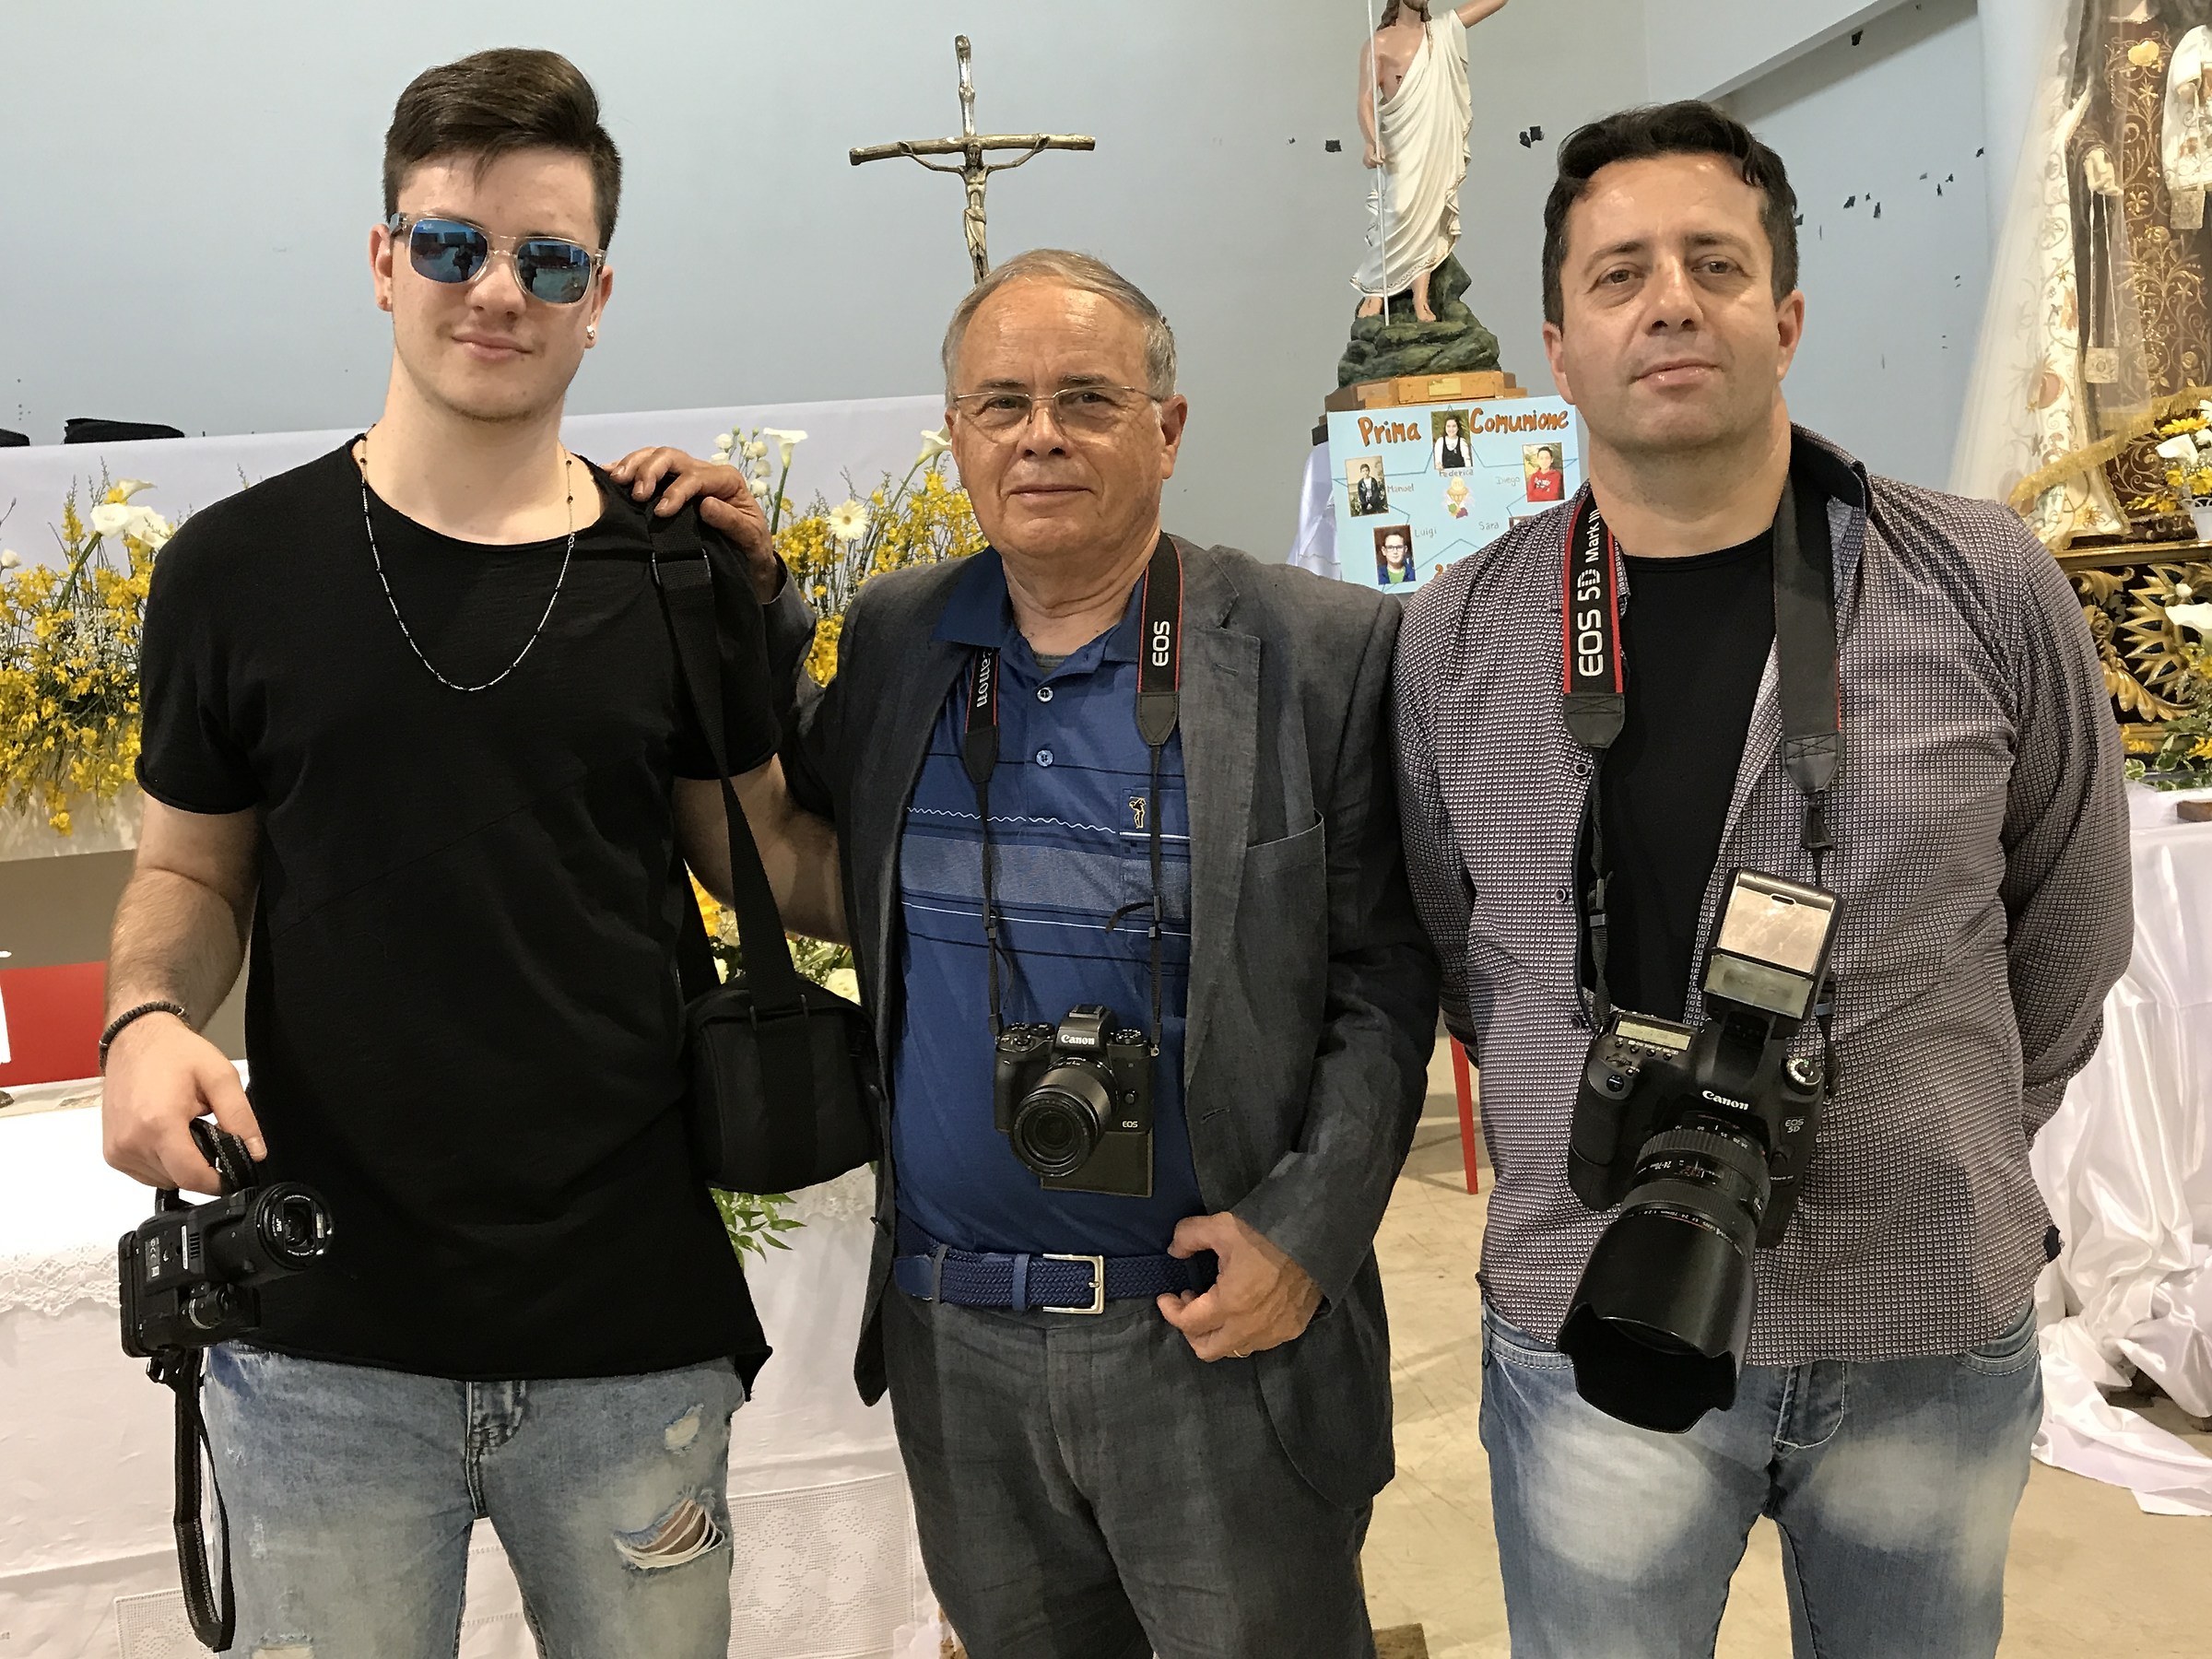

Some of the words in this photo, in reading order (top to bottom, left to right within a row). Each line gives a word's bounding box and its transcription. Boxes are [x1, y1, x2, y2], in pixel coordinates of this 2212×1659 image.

[1469, 406, 1569, 434] Comunione
[1495, 476, 1521, 487] Diego
[1414, 526, 1438, 538] Luigi
[1478, 521, 1500, 531] Sara
[1585, 521, 1600, 563] Mark
[1577, 568, 1602, 602] 5D
[1151, 620, 1171, 667] EOS
[1577, 608, 1604, 677] EOS
[1061, 1034, 1095, 1045] Canon
[1701, 1089, 1749, 1111] Canon
[1122, 1120, 1138, 1128] EOS
[1784, 1118, 1805, 1127] EOS
[1787, 1125, 1801, 1134] 5D
